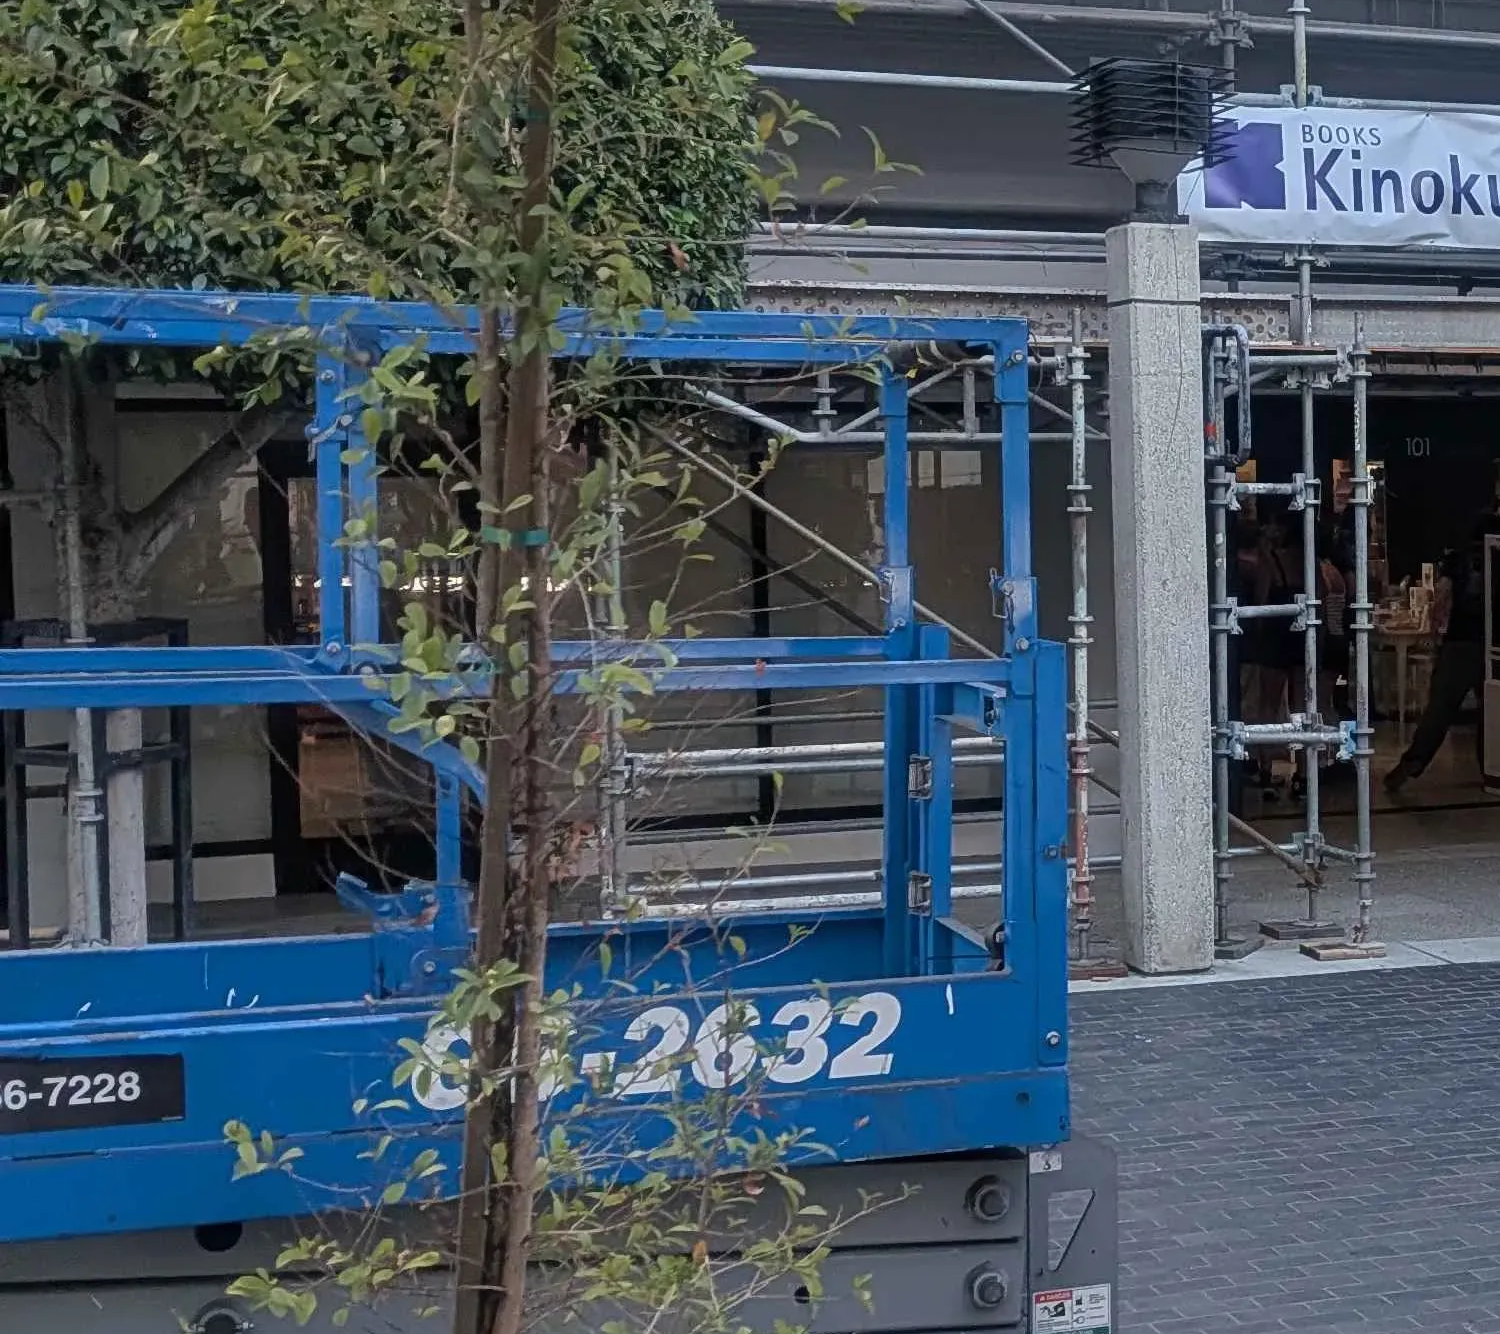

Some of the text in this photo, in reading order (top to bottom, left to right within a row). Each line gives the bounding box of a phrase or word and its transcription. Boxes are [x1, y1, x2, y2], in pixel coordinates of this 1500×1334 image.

[1301, 123, 1382, 147] BOOKS
[1405, 436, 1431, 457] 101
[0, 1071, 142, 1111] 6-7228
